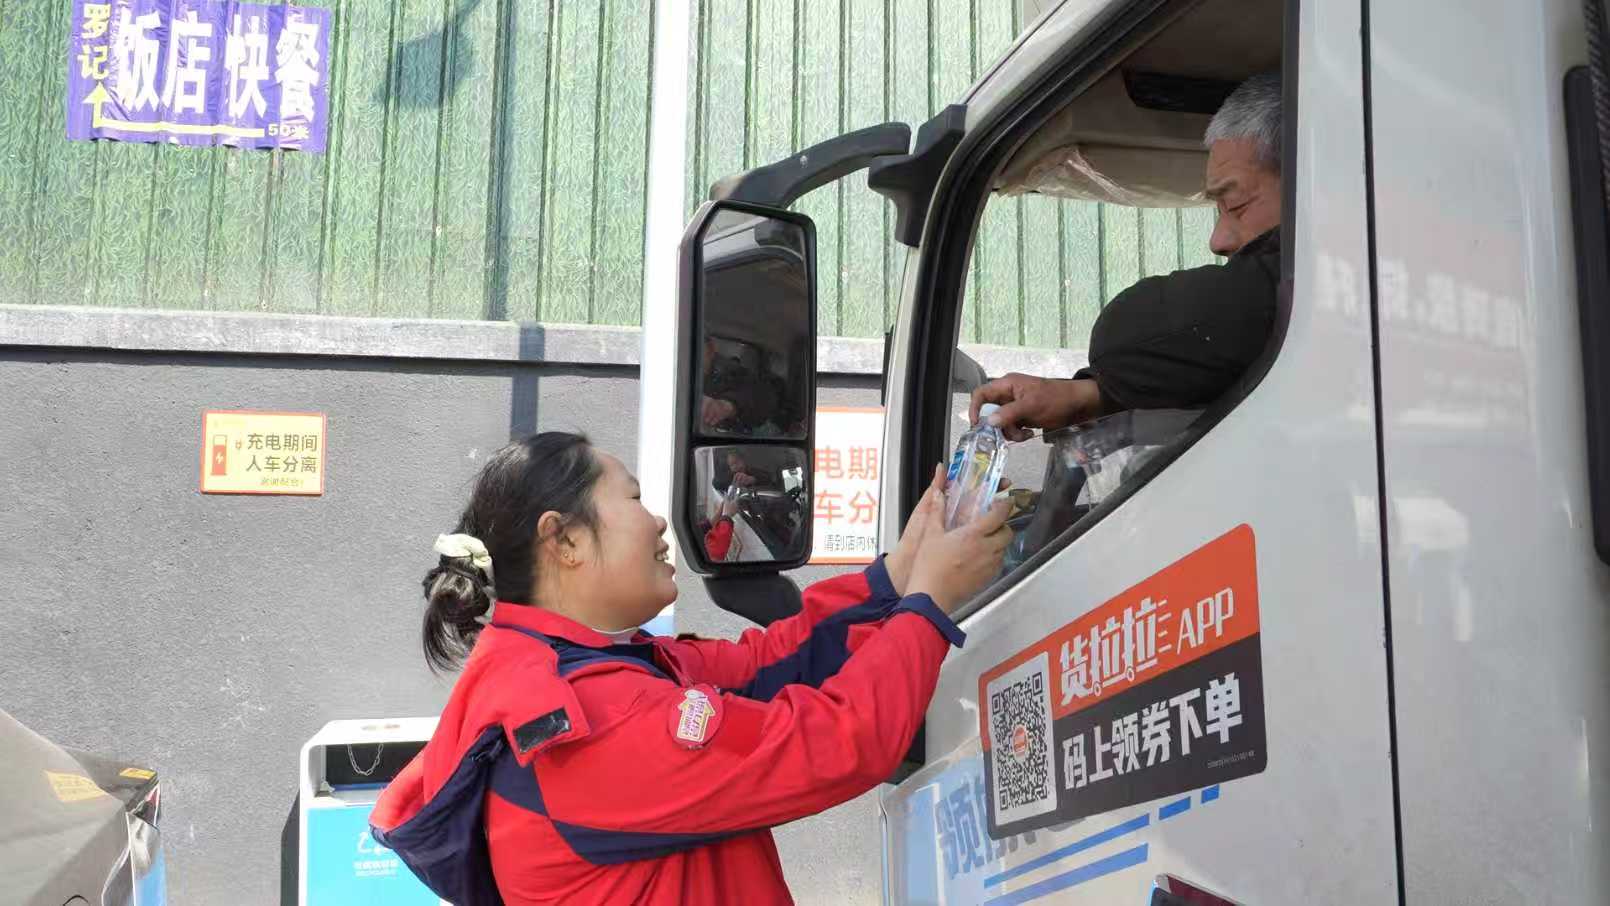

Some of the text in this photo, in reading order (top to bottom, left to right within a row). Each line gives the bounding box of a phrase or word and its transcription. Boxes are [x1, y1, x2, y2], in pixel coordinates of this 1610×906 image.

[78, 3, 111, 79] 罗记
[116, 6, 319, 122] 饭店快餐
[246, 455, 317, 472] 人车分离
[247, 433, 318, 452] 充电期间
[1060, 587, 1234, 705] 货拉拉 APP
[1063, 672, 1243, 789] 码上领券下单
